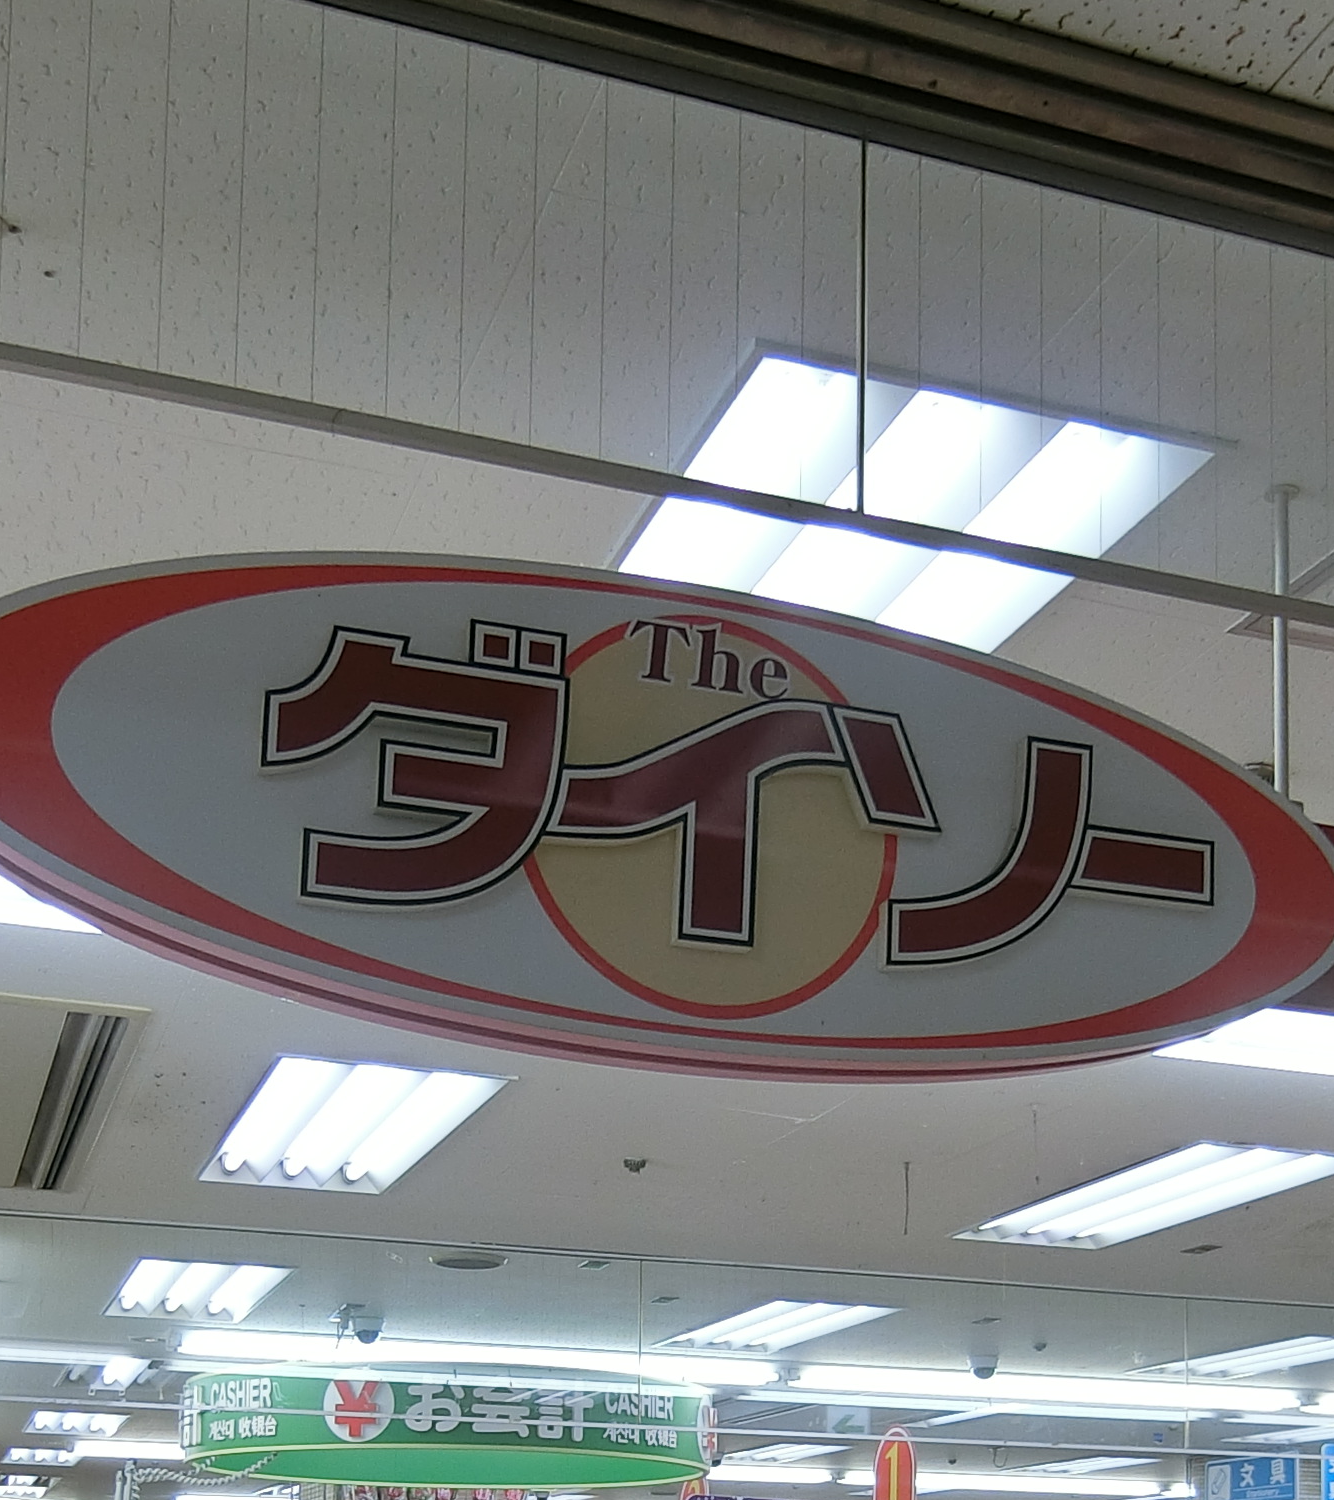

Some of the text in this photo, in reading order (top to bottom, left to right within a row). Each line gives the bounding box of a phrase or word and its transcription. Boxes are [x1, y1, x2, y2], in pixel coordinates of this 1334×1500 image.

[629, 617, 791, 700] The
[261, 617, 1216, 967] ダイソー
[210, 1377, 273, 1413] CASHIER
[405, 1383, 594, 1443] お会計
[604, 1391, 675, 1421] CASHIER
[1240, 1458, 1286, 1486] 文具
